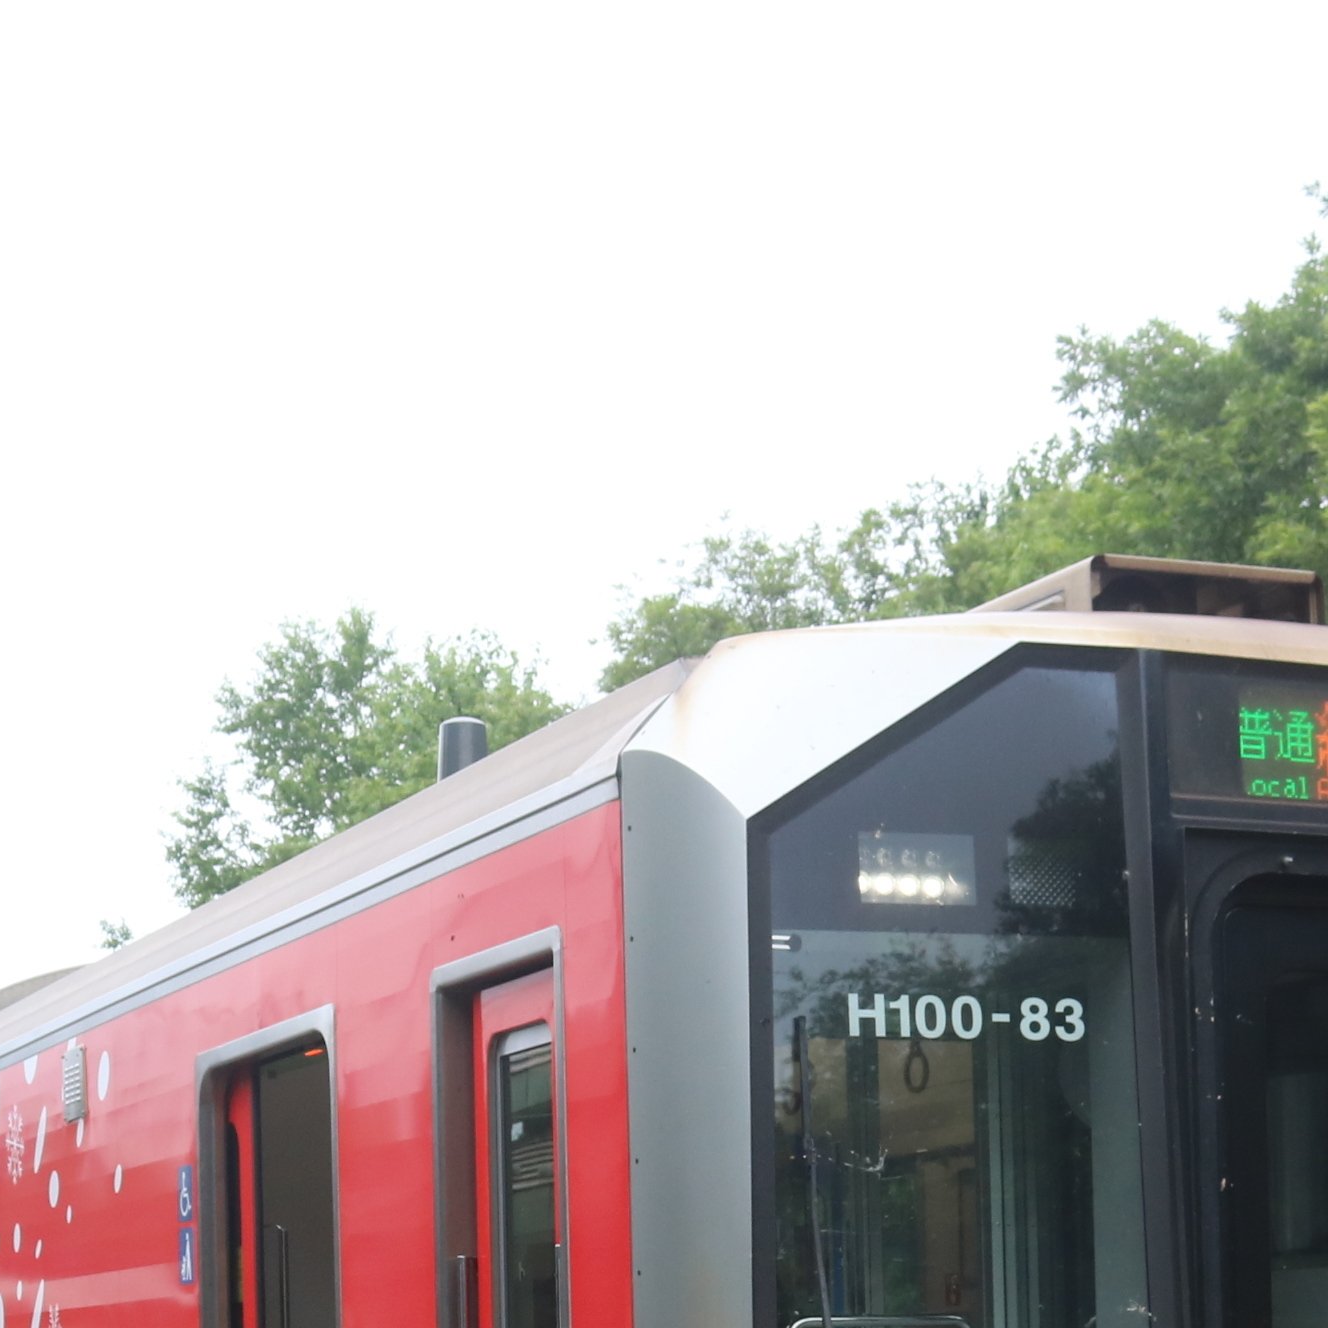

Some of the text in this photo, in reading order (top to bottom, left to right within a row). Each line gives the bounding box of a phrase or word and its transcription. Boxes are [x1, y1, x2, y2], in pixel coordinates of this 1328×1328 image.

[1238, 706, 1315, 763] 普通
[1247, 776, 1310, 800] ocal
[847, 992, 1086, 1043] H100-83
